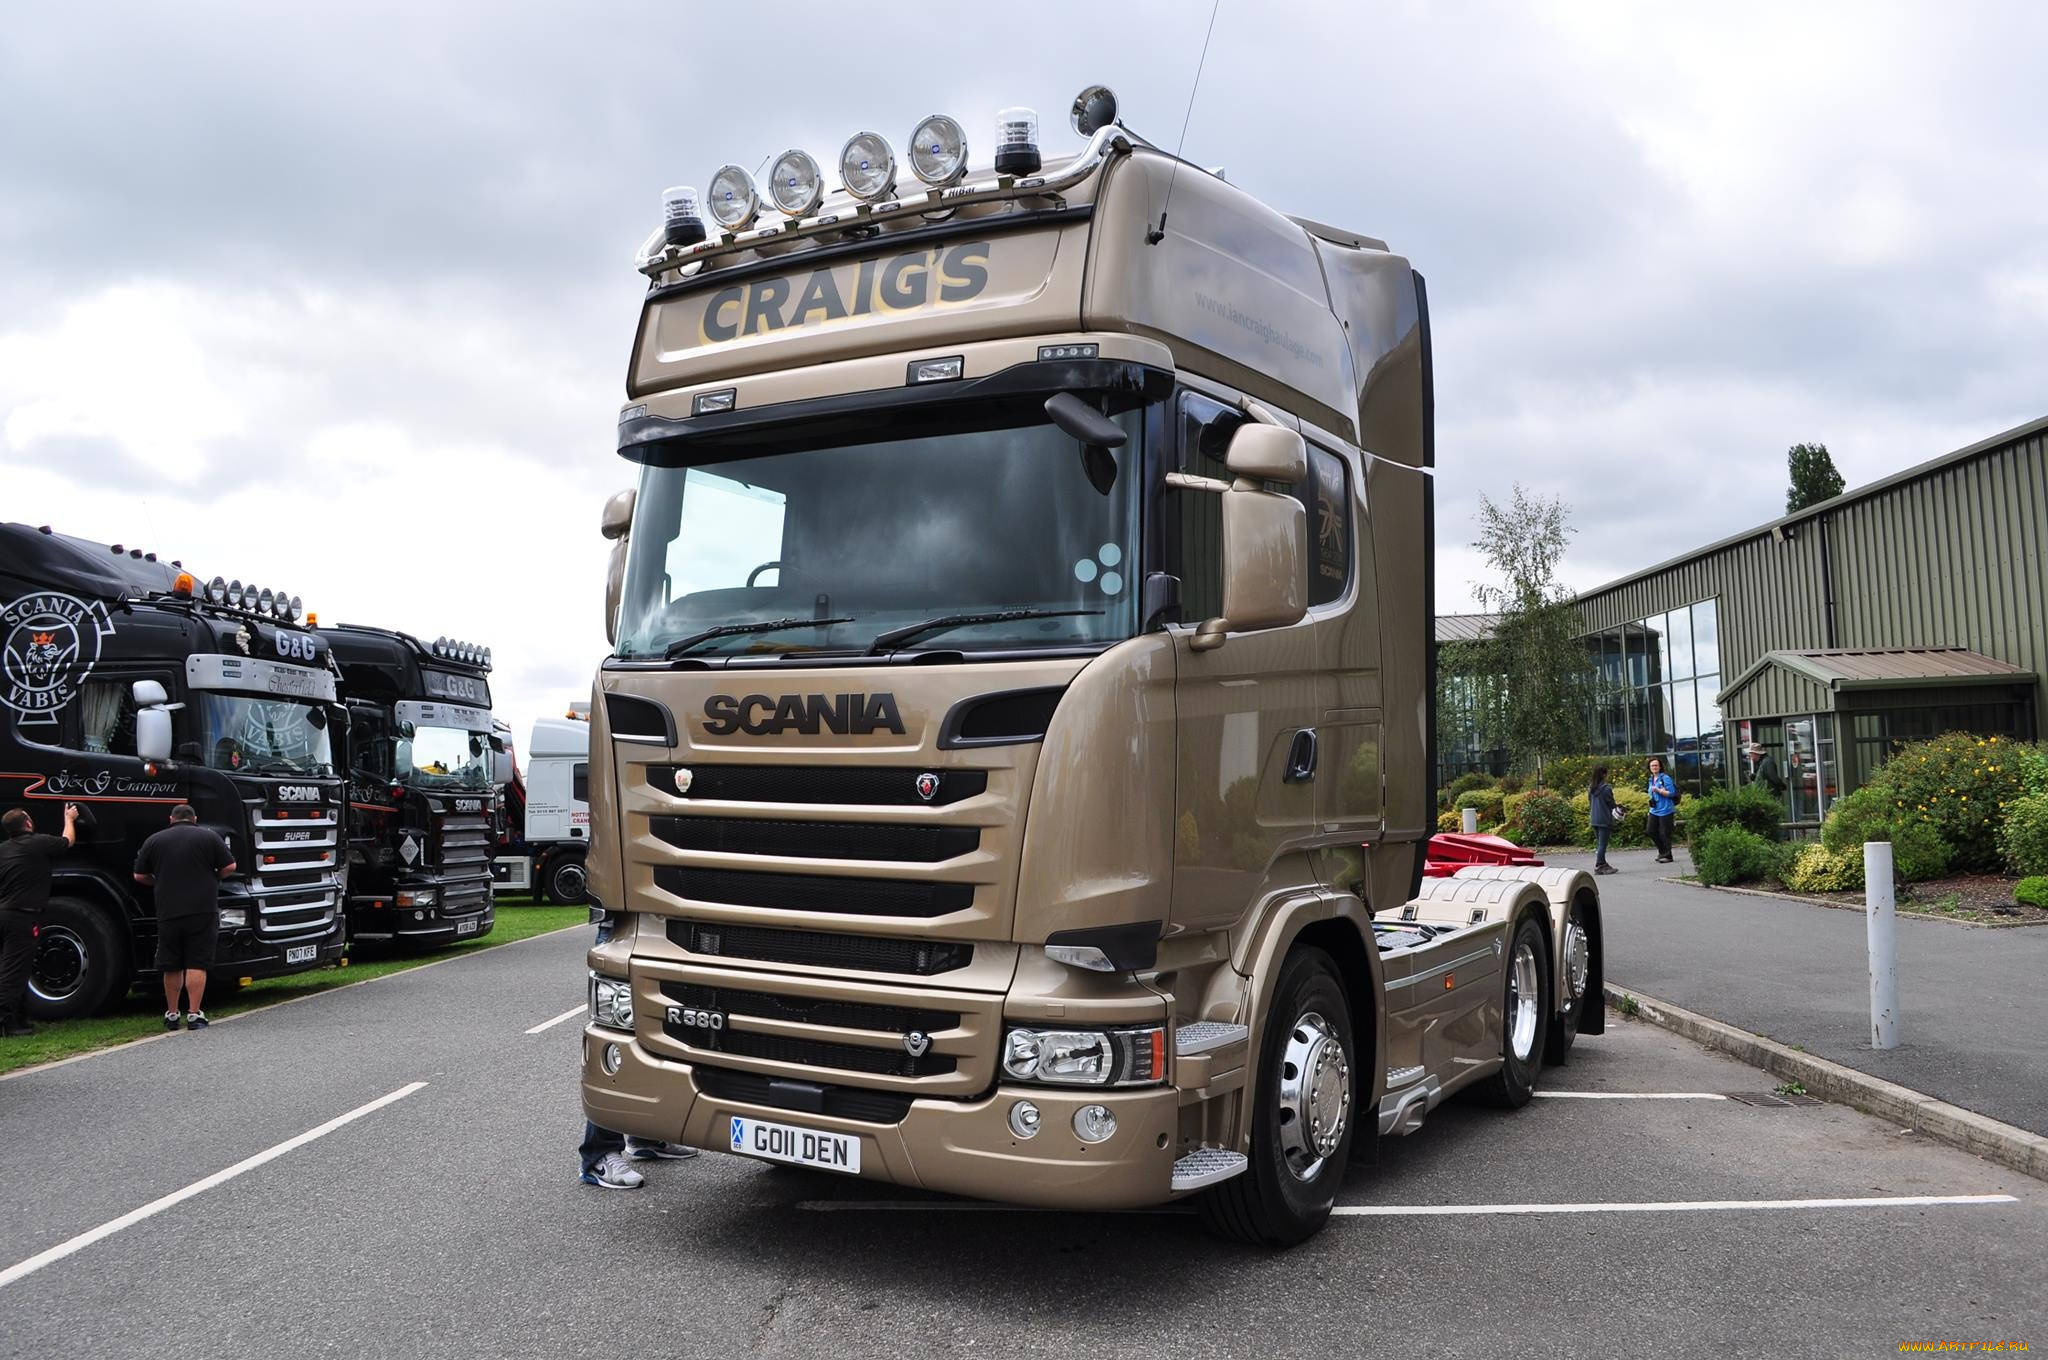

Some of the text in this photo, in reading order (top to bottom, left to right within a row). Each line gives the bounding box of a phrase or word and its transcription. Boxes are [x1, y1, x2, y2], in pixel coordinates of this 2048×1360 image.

[701, 241, 991, 345] CRAIG'S
[4, 597, 84, 627] SCANIA
[275, 630, 316, 661] G&G
[9, 684, 69, 708] VABIS
[446, 674, 475, 699] G&G
[702, 692, 906, 736] SCANIA
[113, 776, 178, 796] Transport
[278, 785, 321, 802] SCANIA
[455, 799, 482, 812] SCANIA
[284, 831, 311, 842] SUPER
[683, 1009, 723, 1030] 580
[802, 1133, 848, 1166] DEN
